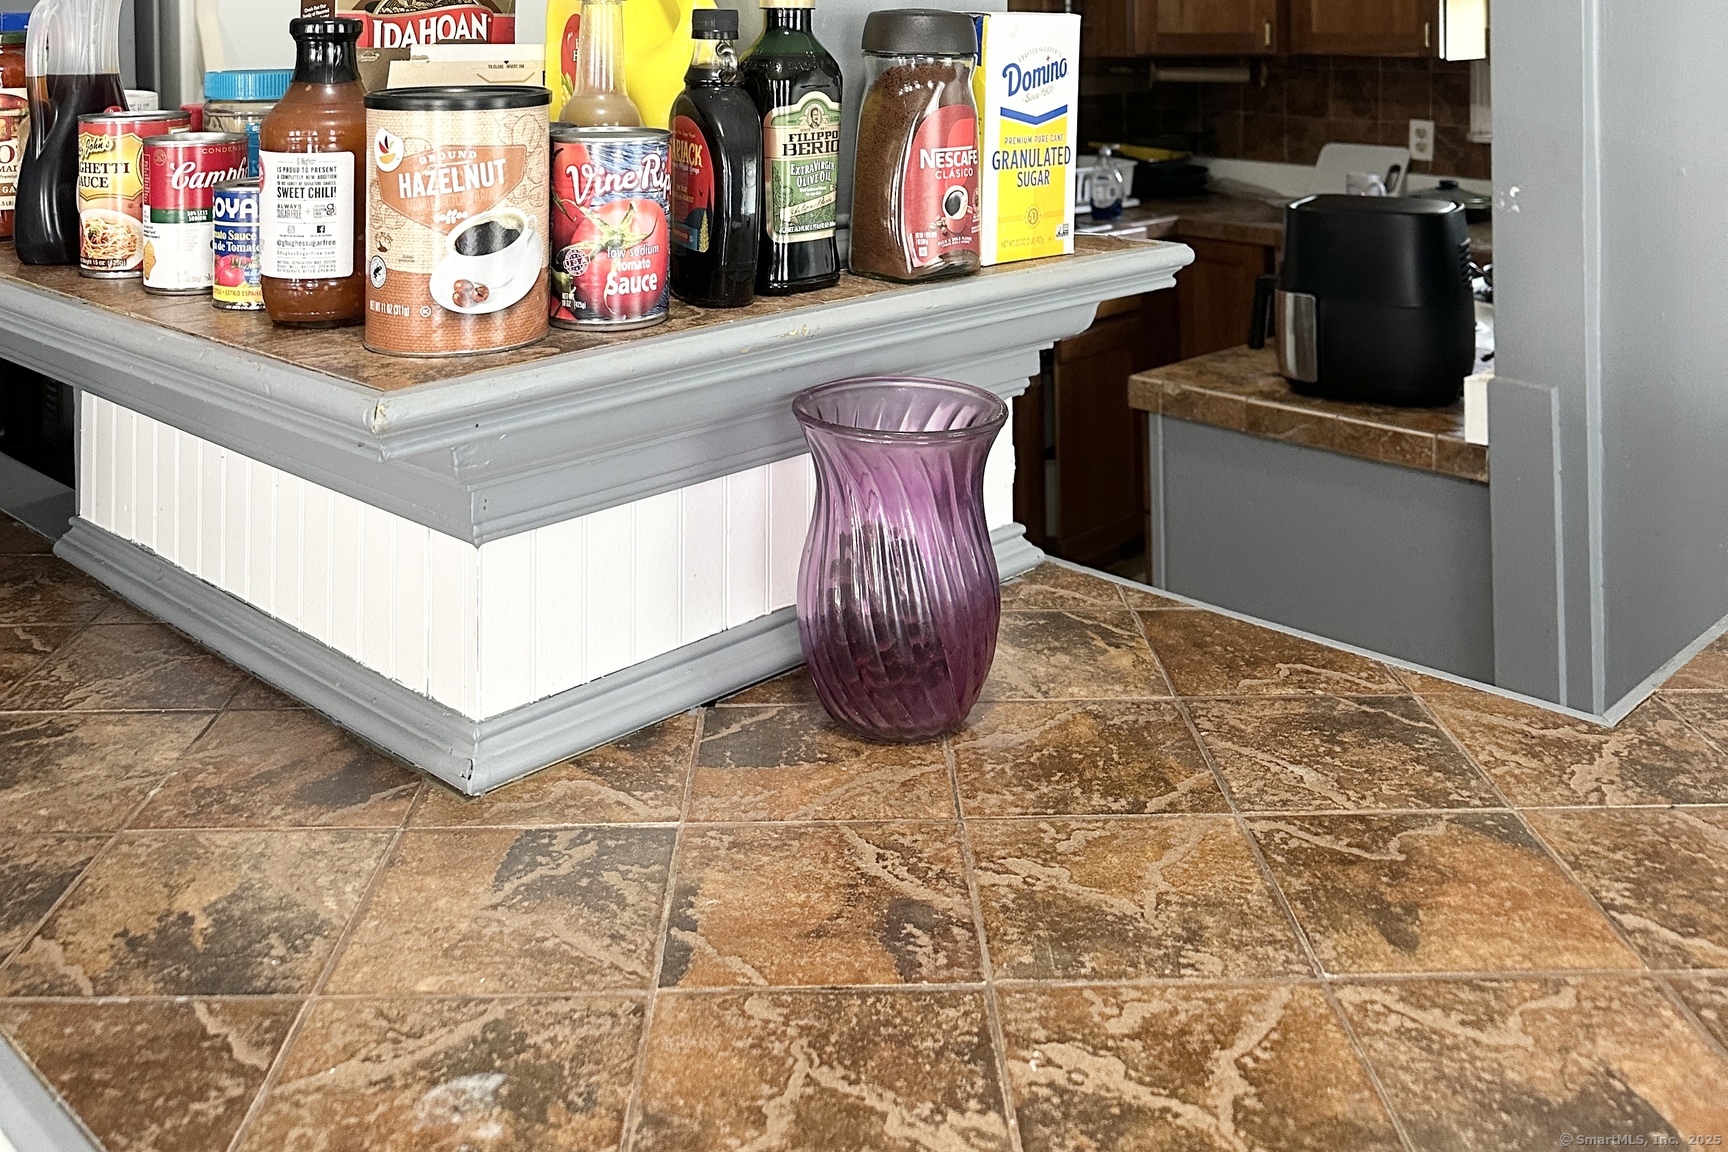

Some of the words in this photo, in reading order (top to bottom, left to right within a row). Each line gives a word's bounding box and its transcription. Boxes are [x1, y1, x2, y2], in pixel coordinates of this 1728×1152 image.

[372, 11, 488, 49] IDAHOAN
[1002, 57, 1067, 97] Domino
[788, 130, 838, 142] FILIPPO
[1005, 136, 1033, 145] PREMIUM
[1034, 134, 1049, 143] PURE
[1050, 133, 1064, 142] CANE
[782, 139, 839, 156] BERIO
[419, 150, 477, 165] GROUND
[992, 146, 1071, 170] GRANULATED
[283, 166, 300, 174] PROUD
[301, 166, 309, 174] TO
[935, 168, 974, 180] CLÁSICO
[398, 158, 506, 199] HAZELNUT
[566, 163, 638, 206] Vine
[1017, 170, 1050, 187] SUGAR
[276, 186, 306, 199] SWEET
[307, 186, 337, 199] CHILI!
[433, 209, 469, 224] coffee
[227, 229, 257, 241] Sauce
[606, 245, 626, 258] low
[629, 242, 660, 257] sodium
[617, 258, 651, 271] tomato
[605, 271, 658, 296] Sauce
